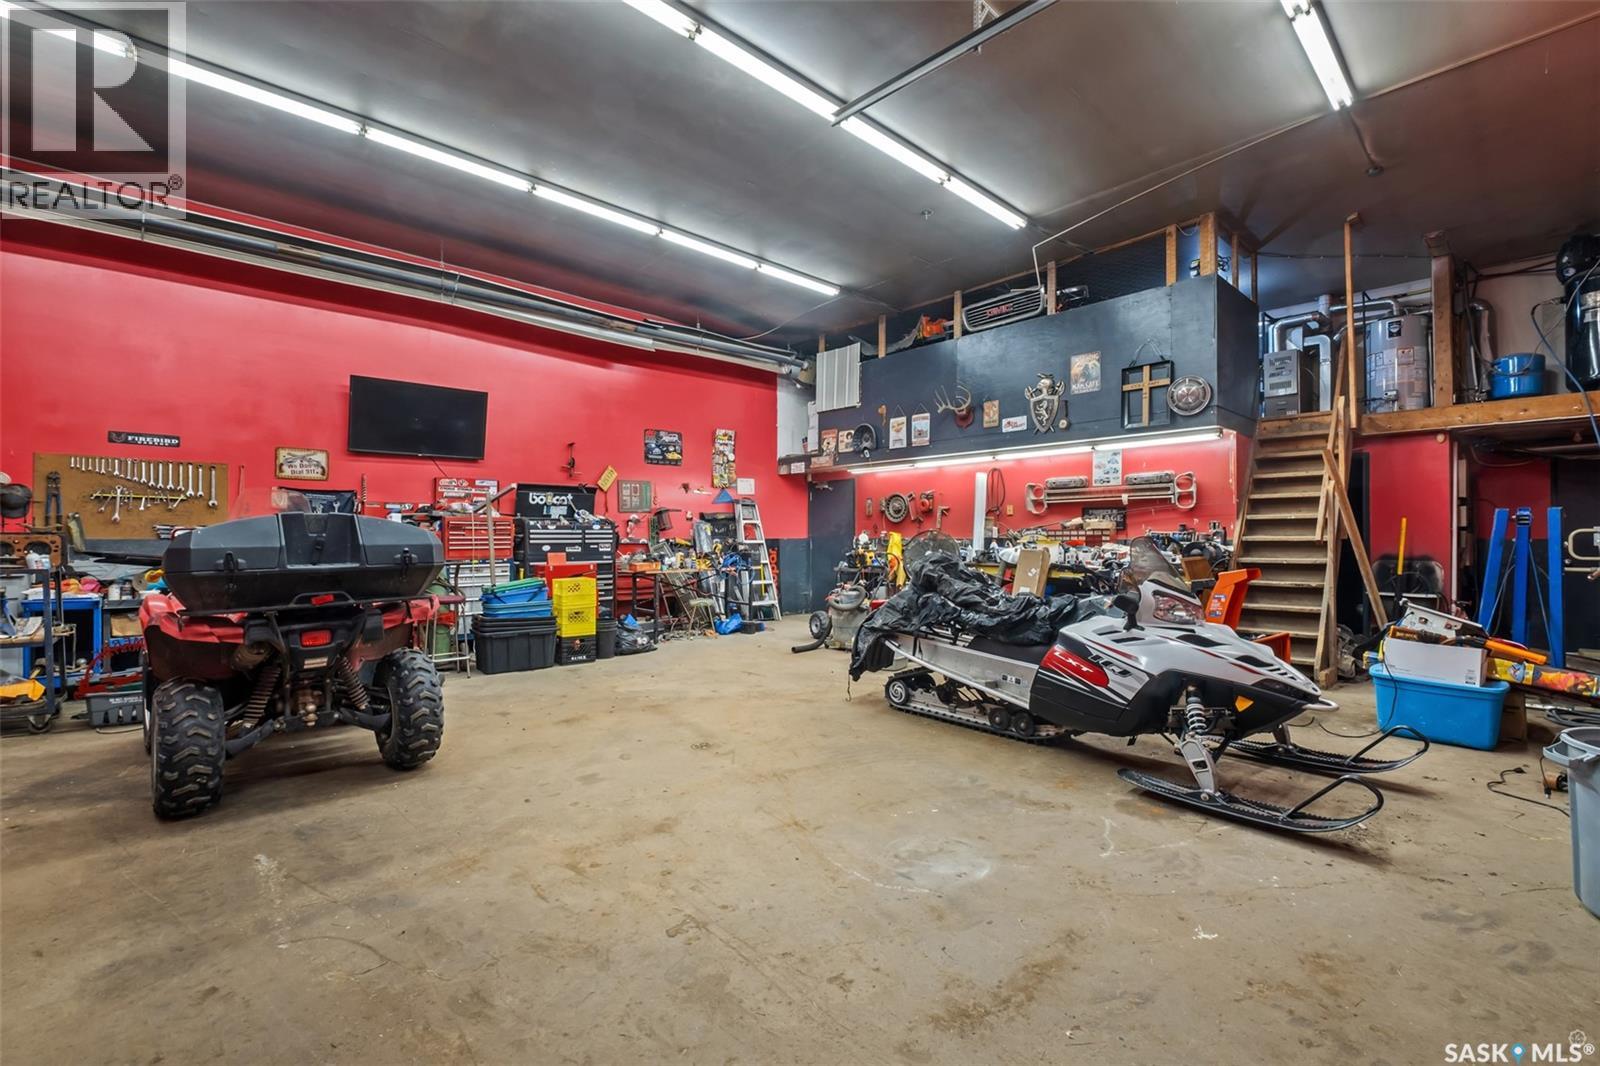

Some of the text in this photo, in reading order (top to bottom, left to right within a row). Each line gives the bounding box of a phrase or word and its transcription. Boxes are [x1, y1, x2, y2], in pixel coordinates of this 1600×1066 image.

[127, 435, 179, 444] FIREBIRD
[529, 492, 573, 505] bocat
[1053, 651, 1094, 673] LXT
